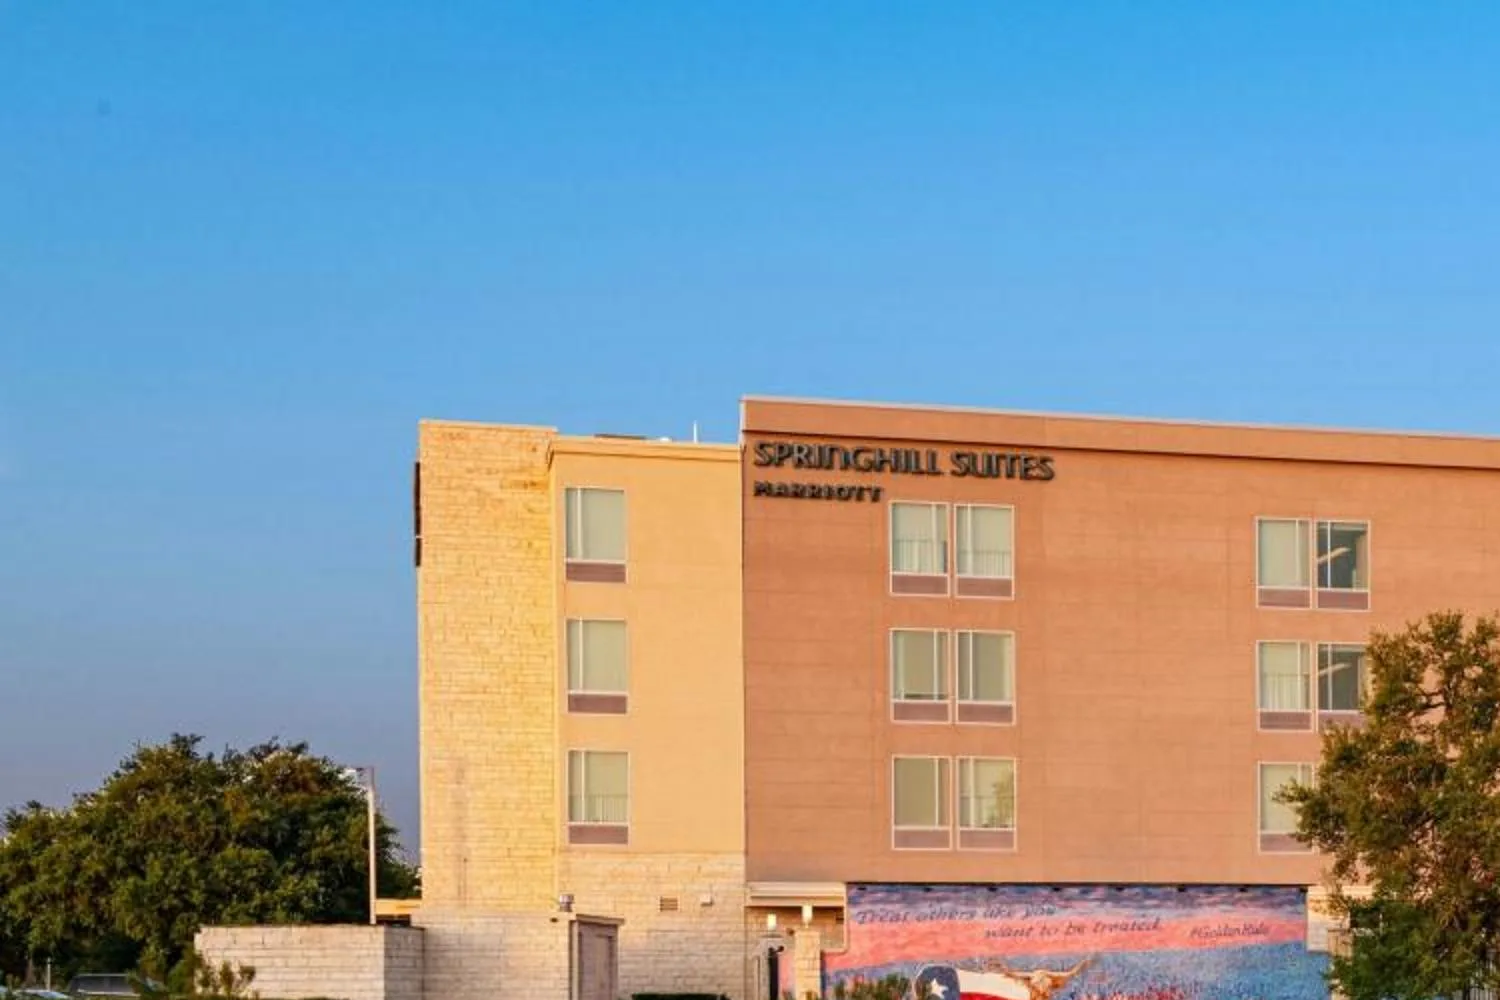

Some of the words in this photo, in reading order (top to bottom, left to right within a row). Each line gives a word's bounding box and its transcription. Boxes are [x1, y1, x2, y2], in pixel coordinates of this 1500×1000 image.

[753, 442, 944, 476] SPRINGHILL
[951, 451, 1055, 481] SUITES
[754, 480, 884, 502] MARRIOTT
[856, 909, 910, 925] Treat
[915, 903, 976, 921] others
[985, 926, 1034, 938] want
[1039, 924, 1059, 937] to
[1064, 920, 1086, 936] be
